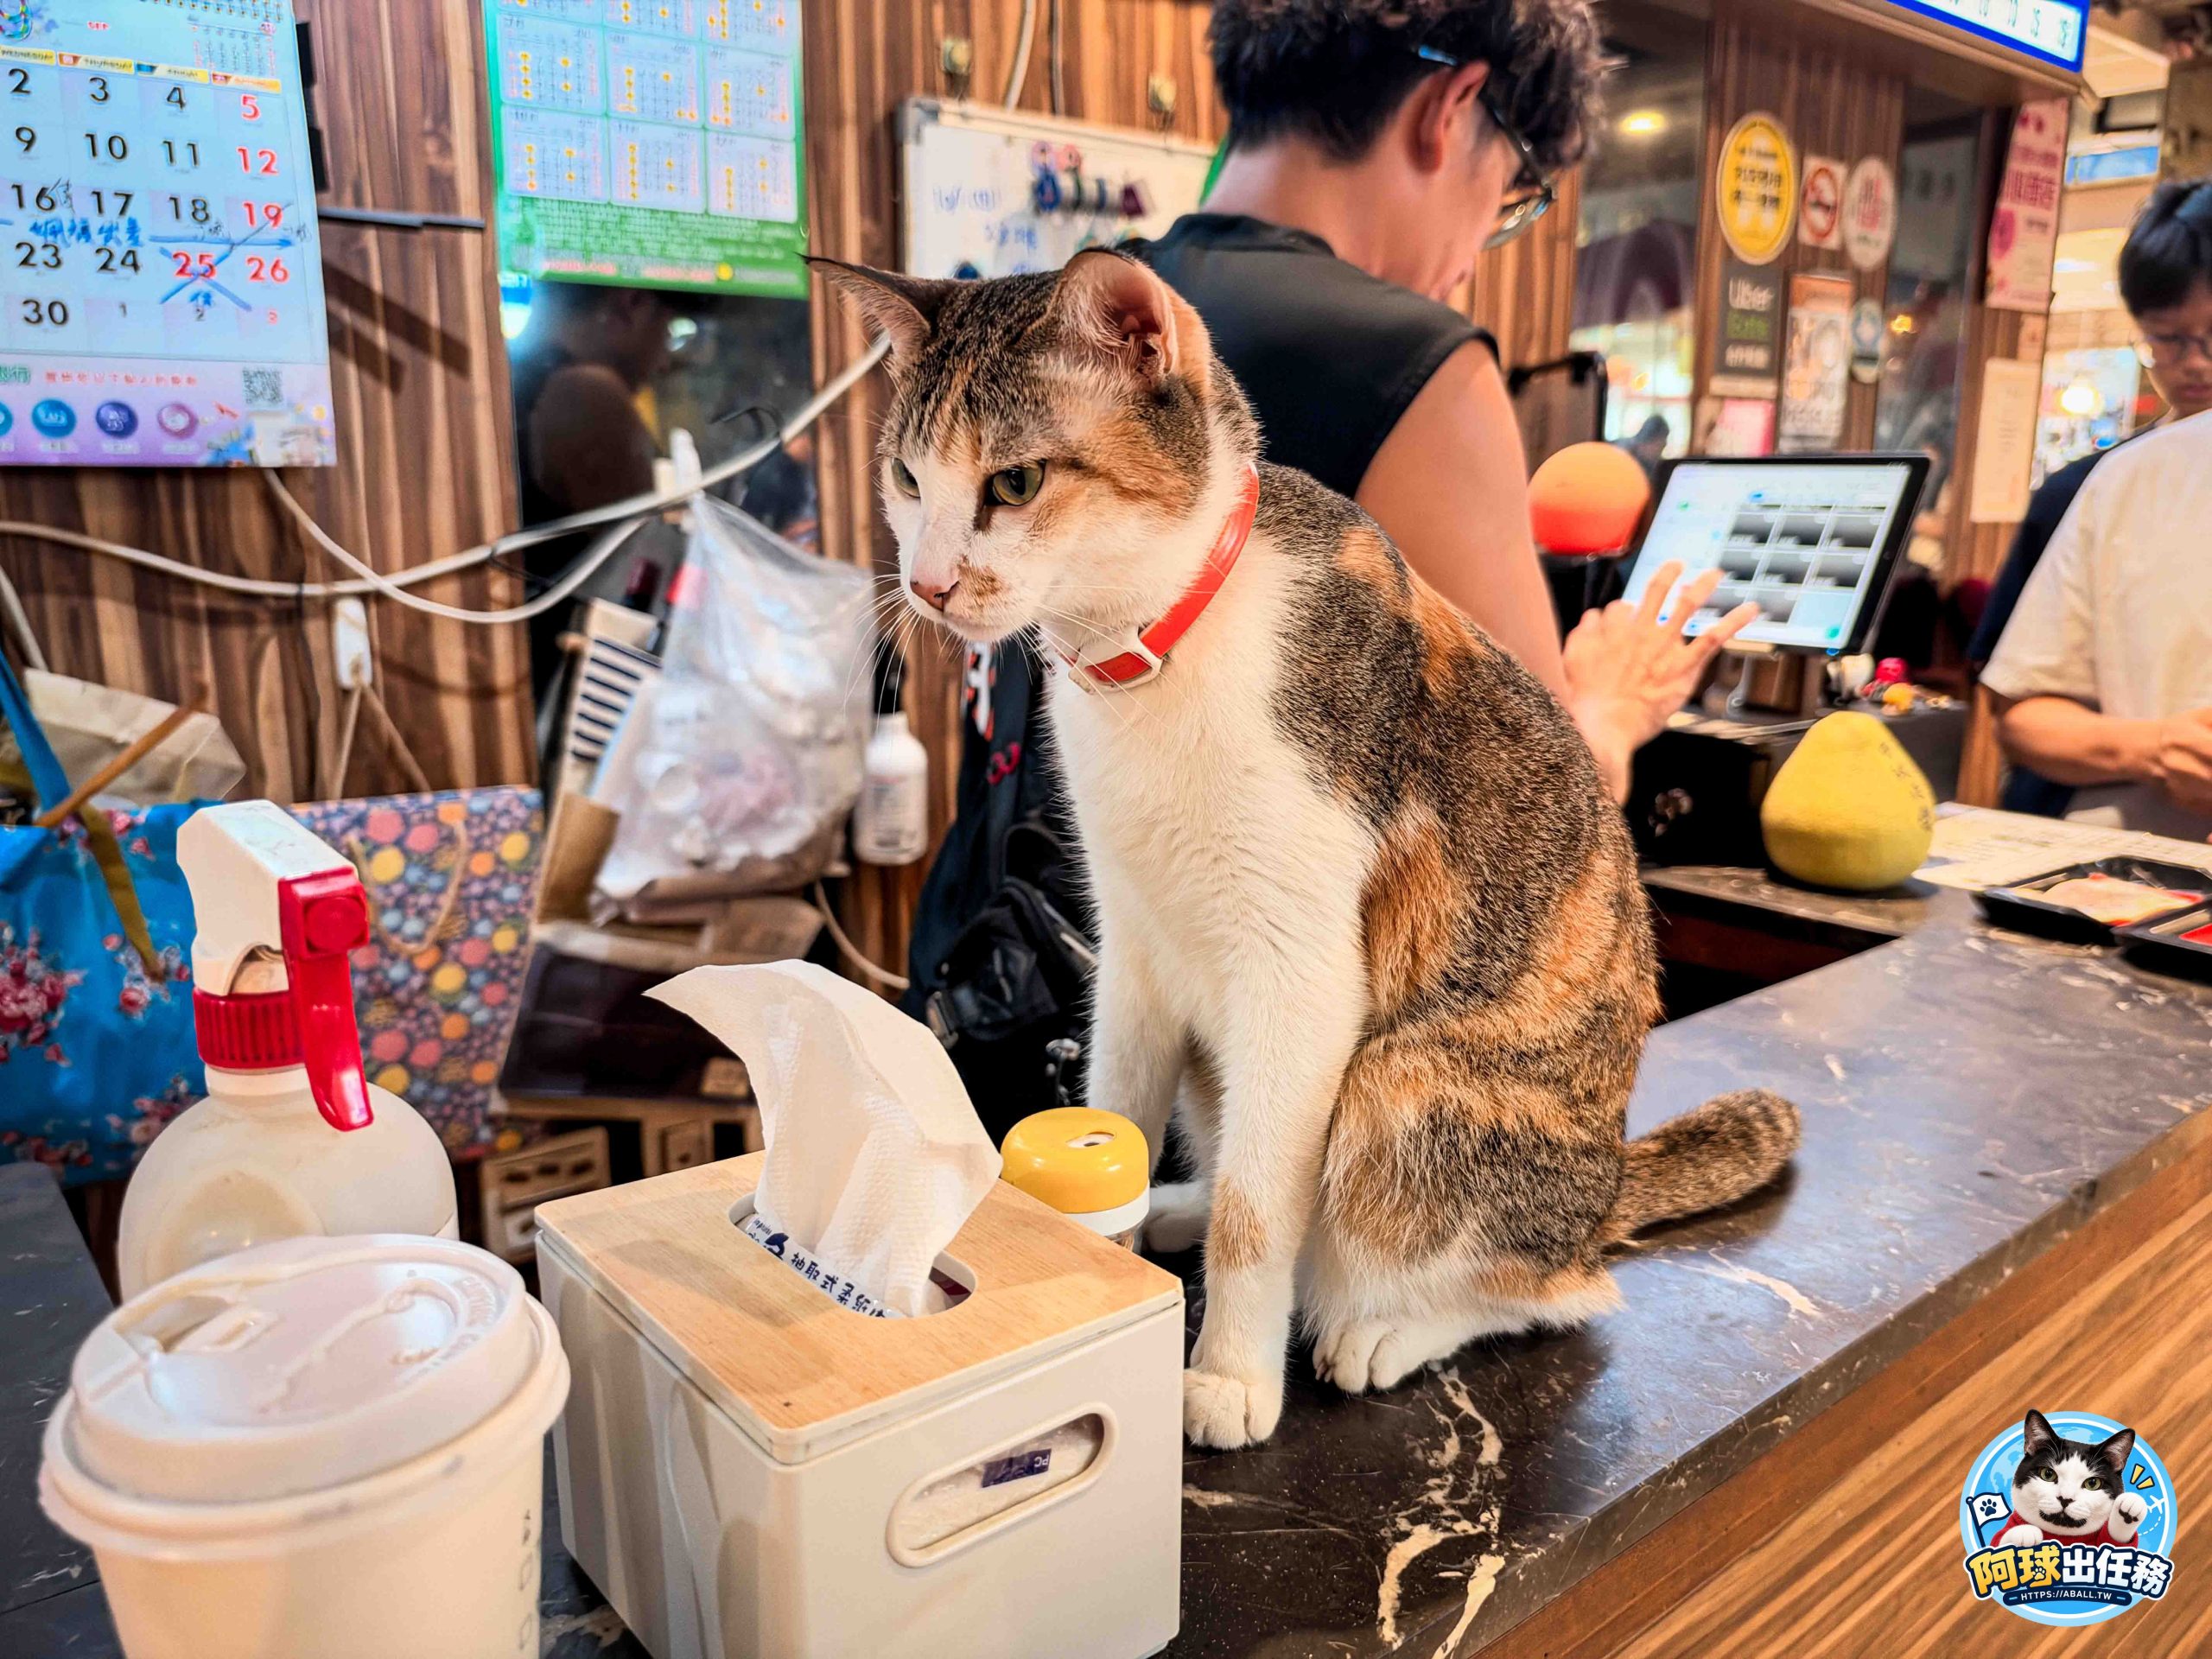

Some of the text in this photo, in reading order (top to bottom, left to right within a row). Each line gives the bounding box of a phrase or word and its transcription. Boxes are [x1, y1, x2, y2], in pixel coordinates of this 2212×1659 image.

[9, 68, 261, 121] 2 3 4 5
[16, 127, 278, 175] 9 10 11 12
[11, 184, 55, 212] 16
[92, 191, 133, 216] 17
[169, 196, 210, 223] 18
[244, 202, 283, 228] 19
[16, 242, 289, 283] 23 24 25 26
[22, 300, 69, 326] 30
[119, 303, 127, 317] 1
[1729, 277, 1774, 312] Uber
